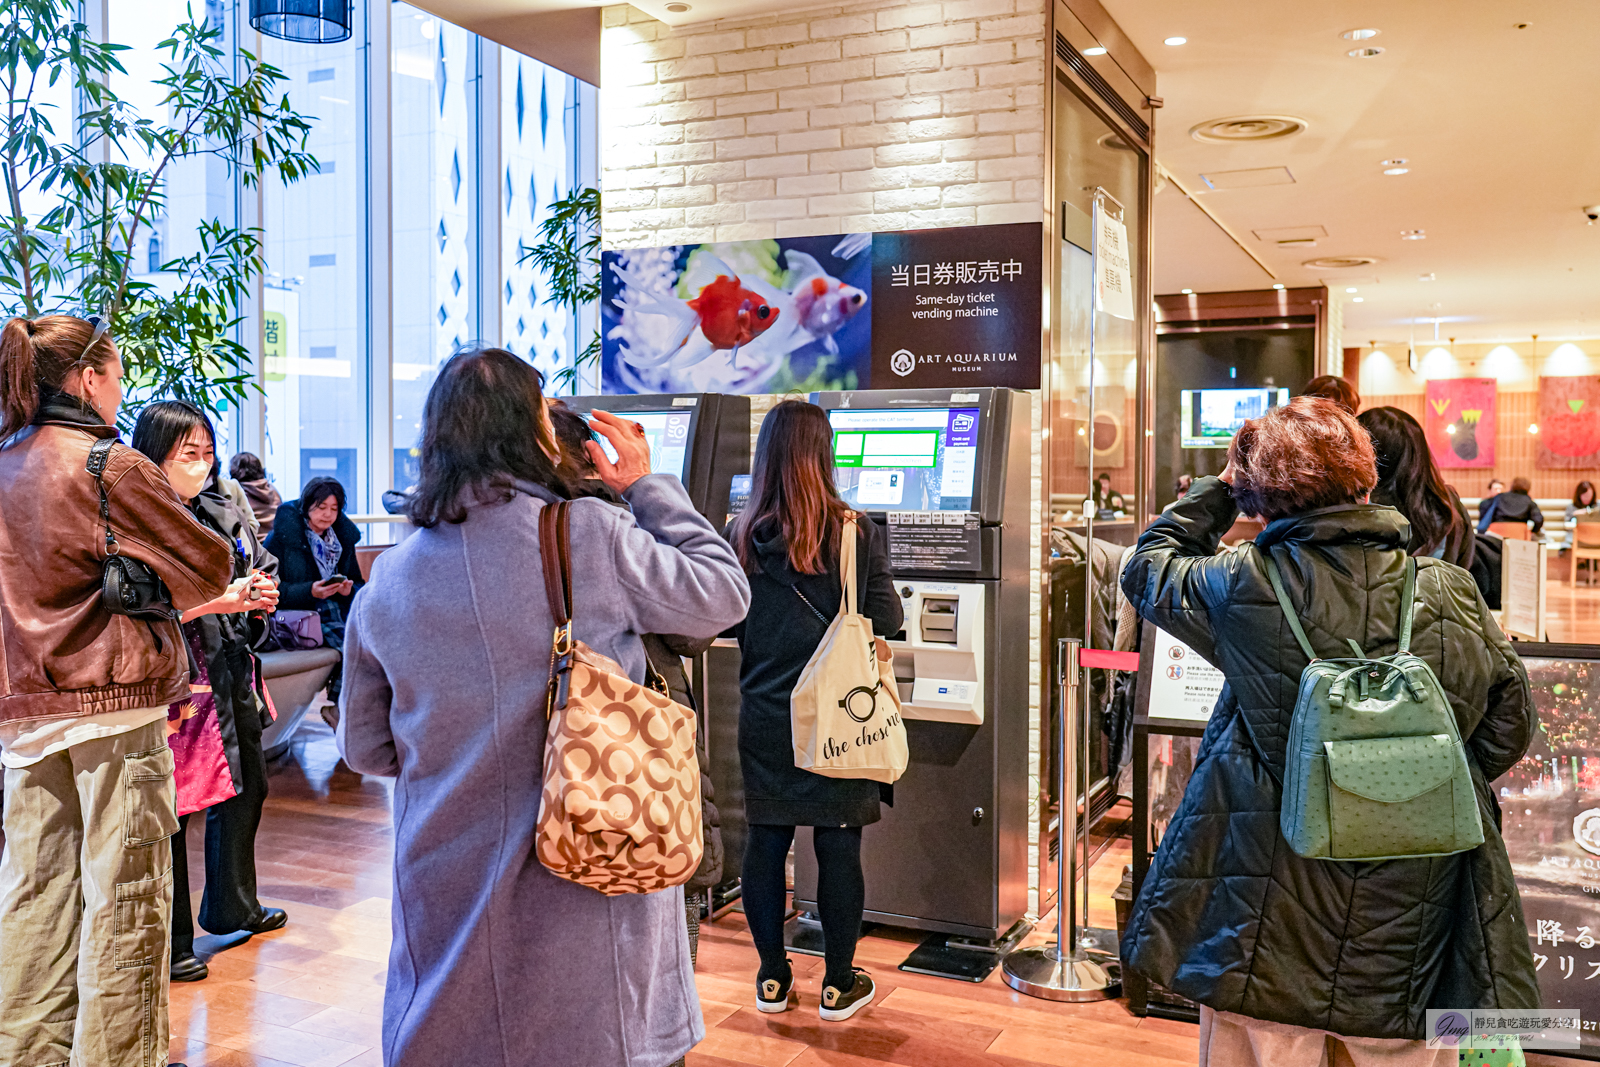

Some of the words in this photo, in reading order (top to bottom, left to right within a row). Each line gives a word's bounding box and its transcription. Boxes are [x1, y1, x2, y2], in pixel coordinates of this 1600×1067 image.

[890, 258, 1023, 287] 当日券販売中
[915, 294, 965, 308] Same-day
[966, 292, 995, 304] ticket
[912, 307, 952, 320] vending
[955, 306, 999, 317] machine
[918, 354, 942, 364] ART
[945, 352, 1018, 364] AQUARIUM
[823, 737, 850, 760] the
[1540, 856, 1570, 866] ART
[1536, 919, 1596, 949] 降る
[1558, 1017, 1600, 1031] 12月27
